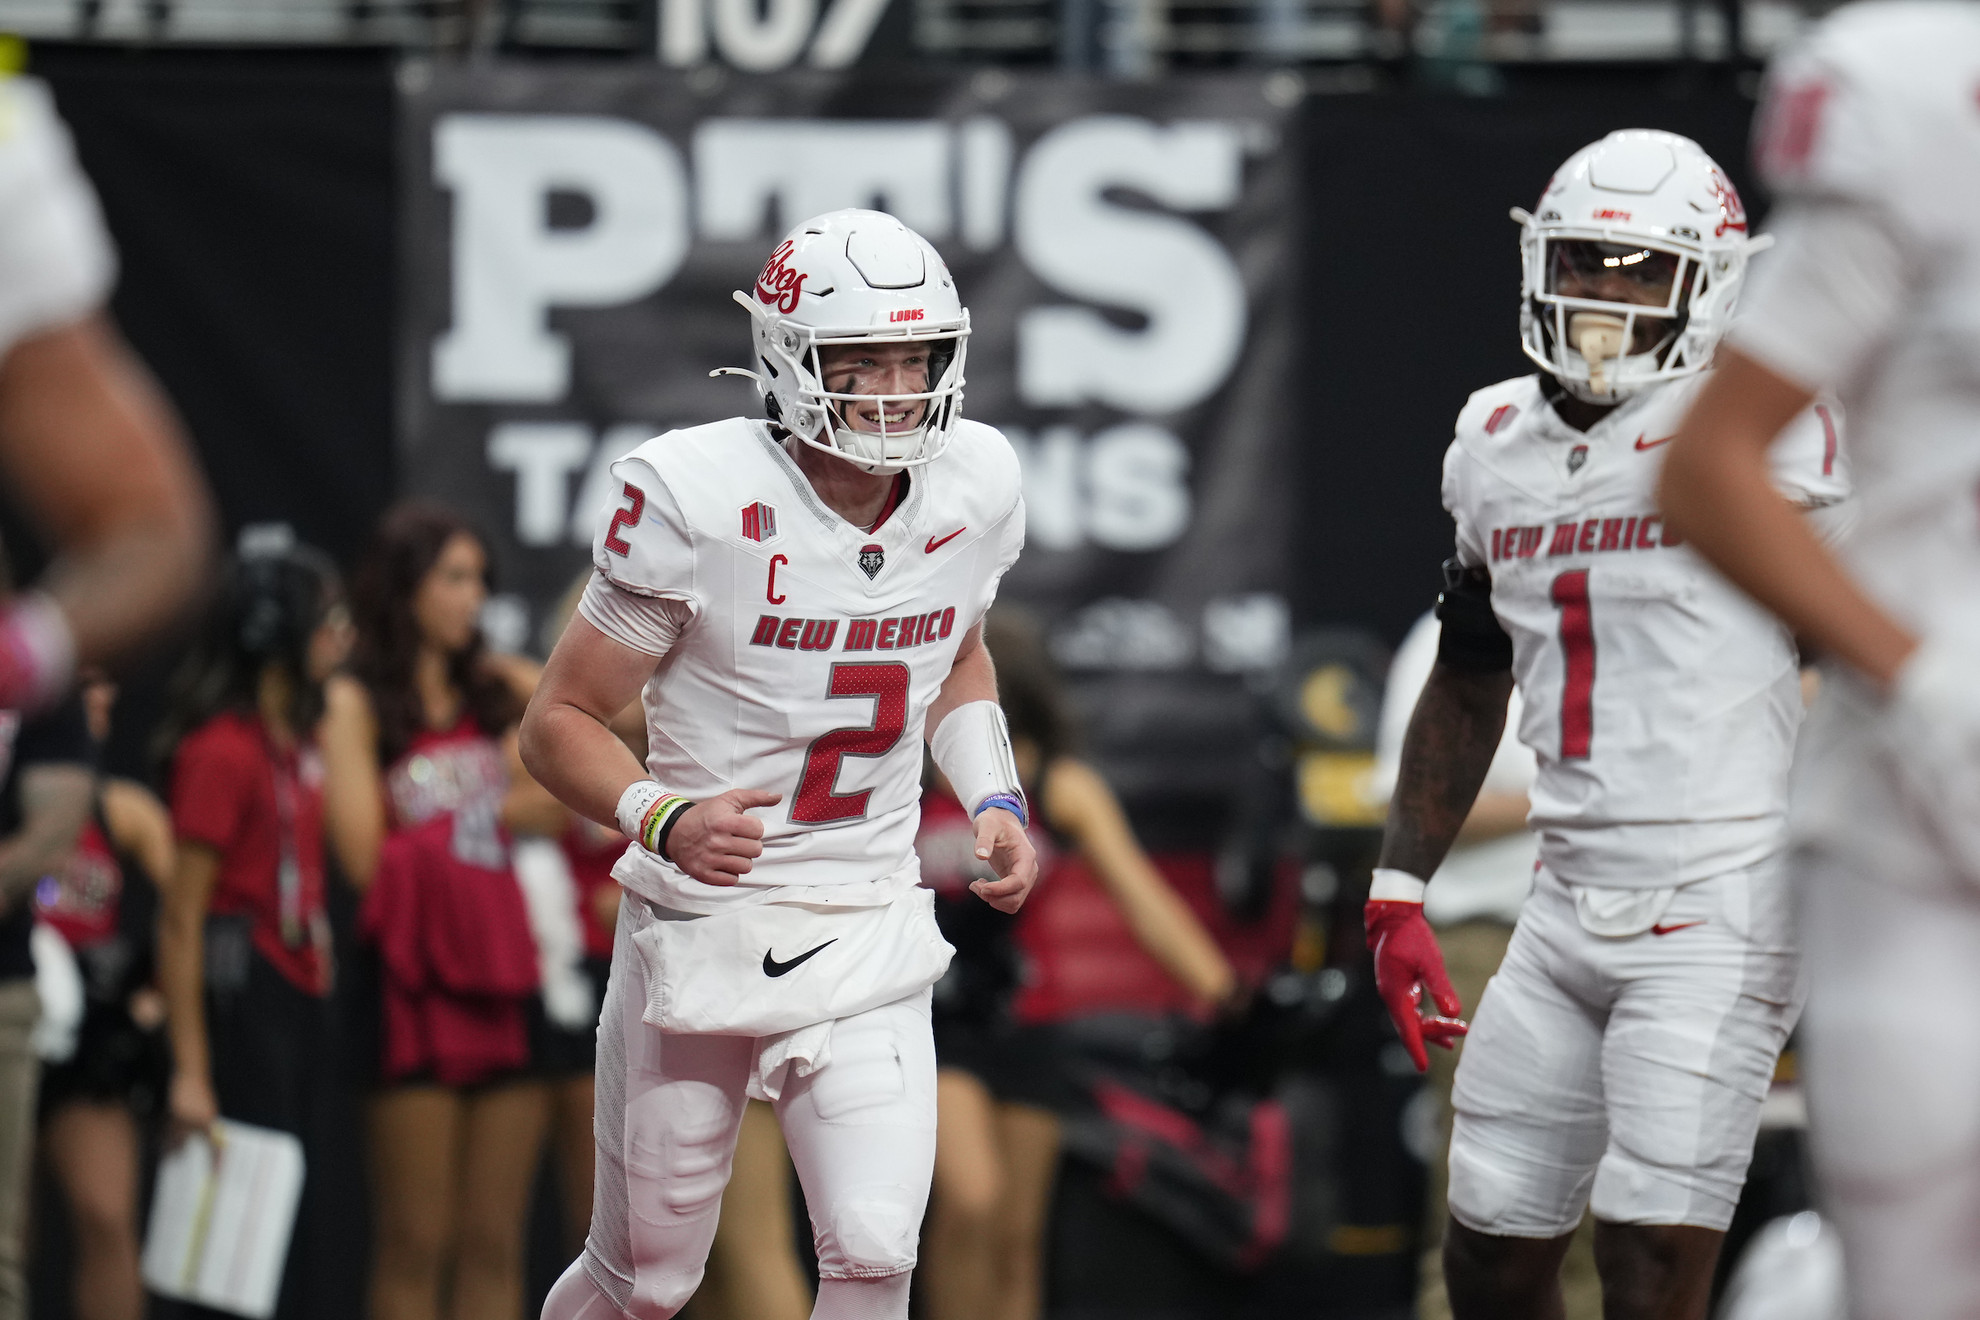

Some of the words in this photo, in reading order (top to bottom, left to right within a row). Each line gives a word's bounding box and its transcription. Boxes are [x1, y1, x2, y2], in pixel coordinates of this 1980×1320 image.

[889, 308, 925, 323] LOBOS
[604, 481, 646, 558] 2
[766, 553, 788, 605] C
[748, 614, 840, 651] NEW
[842, 606, 957, 652] MEXICO
[1550, 567, 1597, 761] 1
[786, 660, 912, 824] 2
